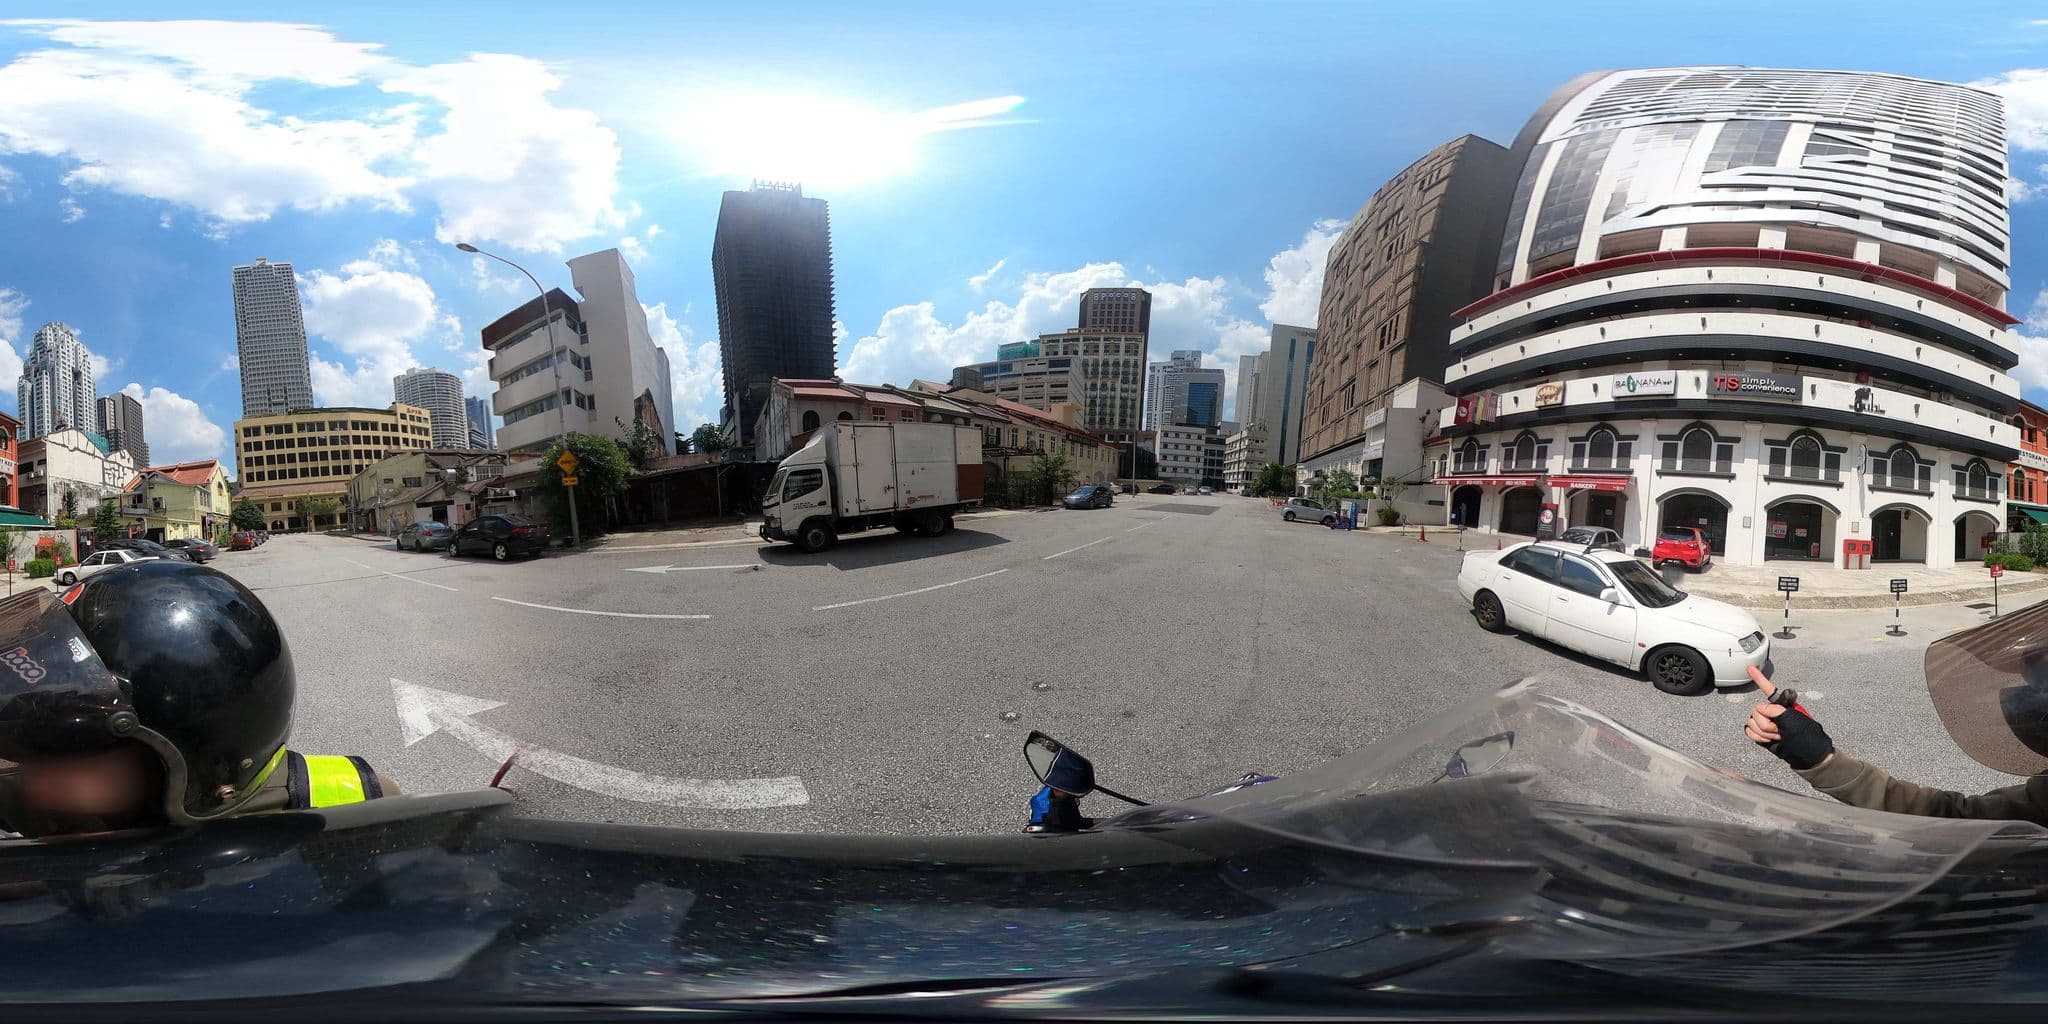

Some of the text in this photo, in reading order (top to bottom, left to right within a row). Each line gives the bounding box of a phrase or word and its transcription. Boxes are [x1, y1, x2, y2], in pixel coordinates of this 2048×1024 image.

[1742, 377, 1776, 386] simply
[1741, 383, 1796, 393] convenience
[2019, 450, 2042, 461] ESTORAN
